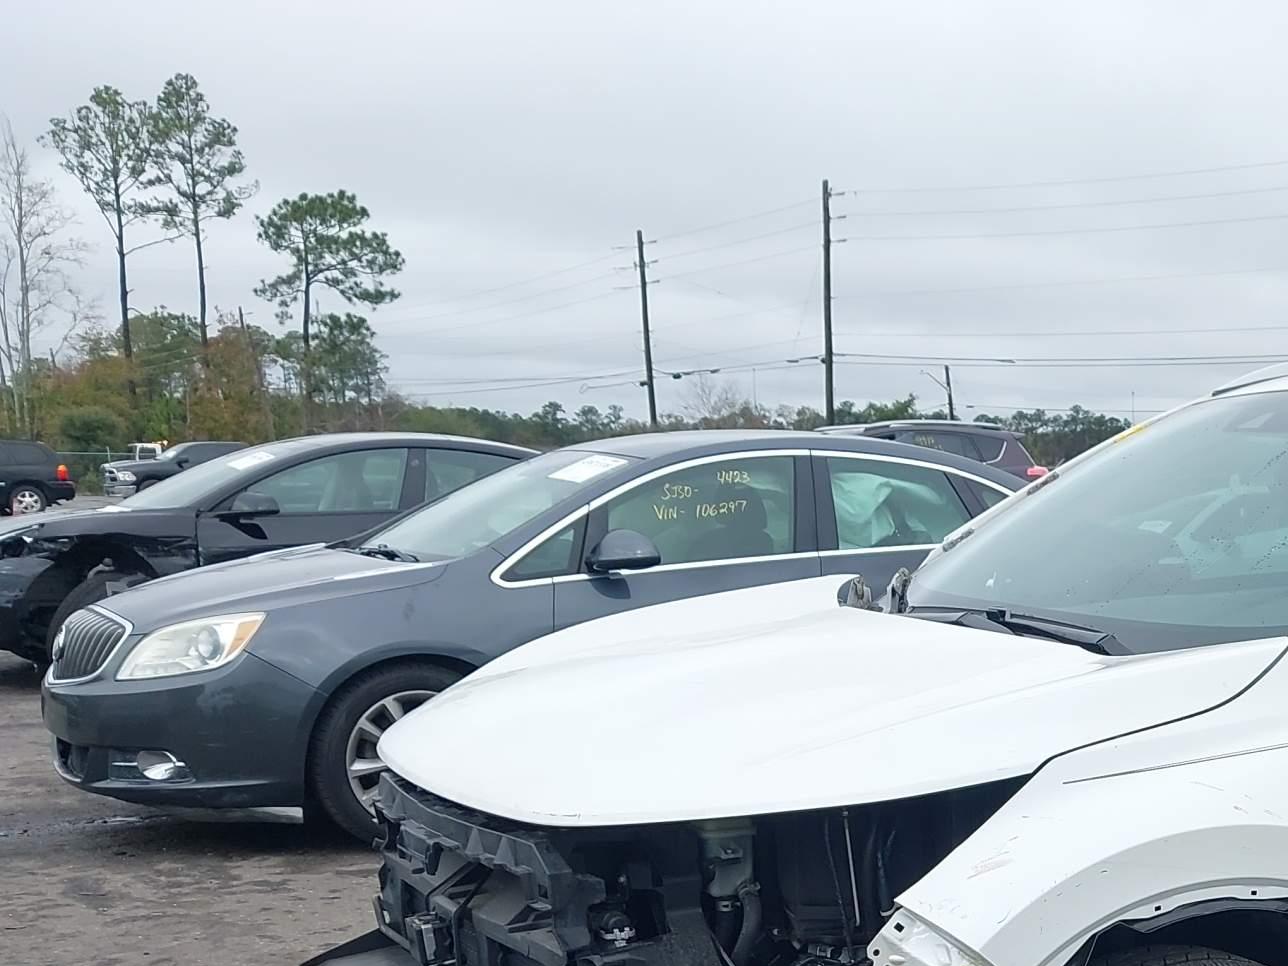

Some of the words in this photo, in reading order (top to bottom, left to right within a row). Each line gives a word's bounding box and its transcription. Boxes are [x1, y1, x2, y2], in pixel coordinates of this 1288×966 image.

[717, 470, 751, 485] 4423
[652, 504, 686, 521] VIN-
[695, 500, 747, 520] 106297
